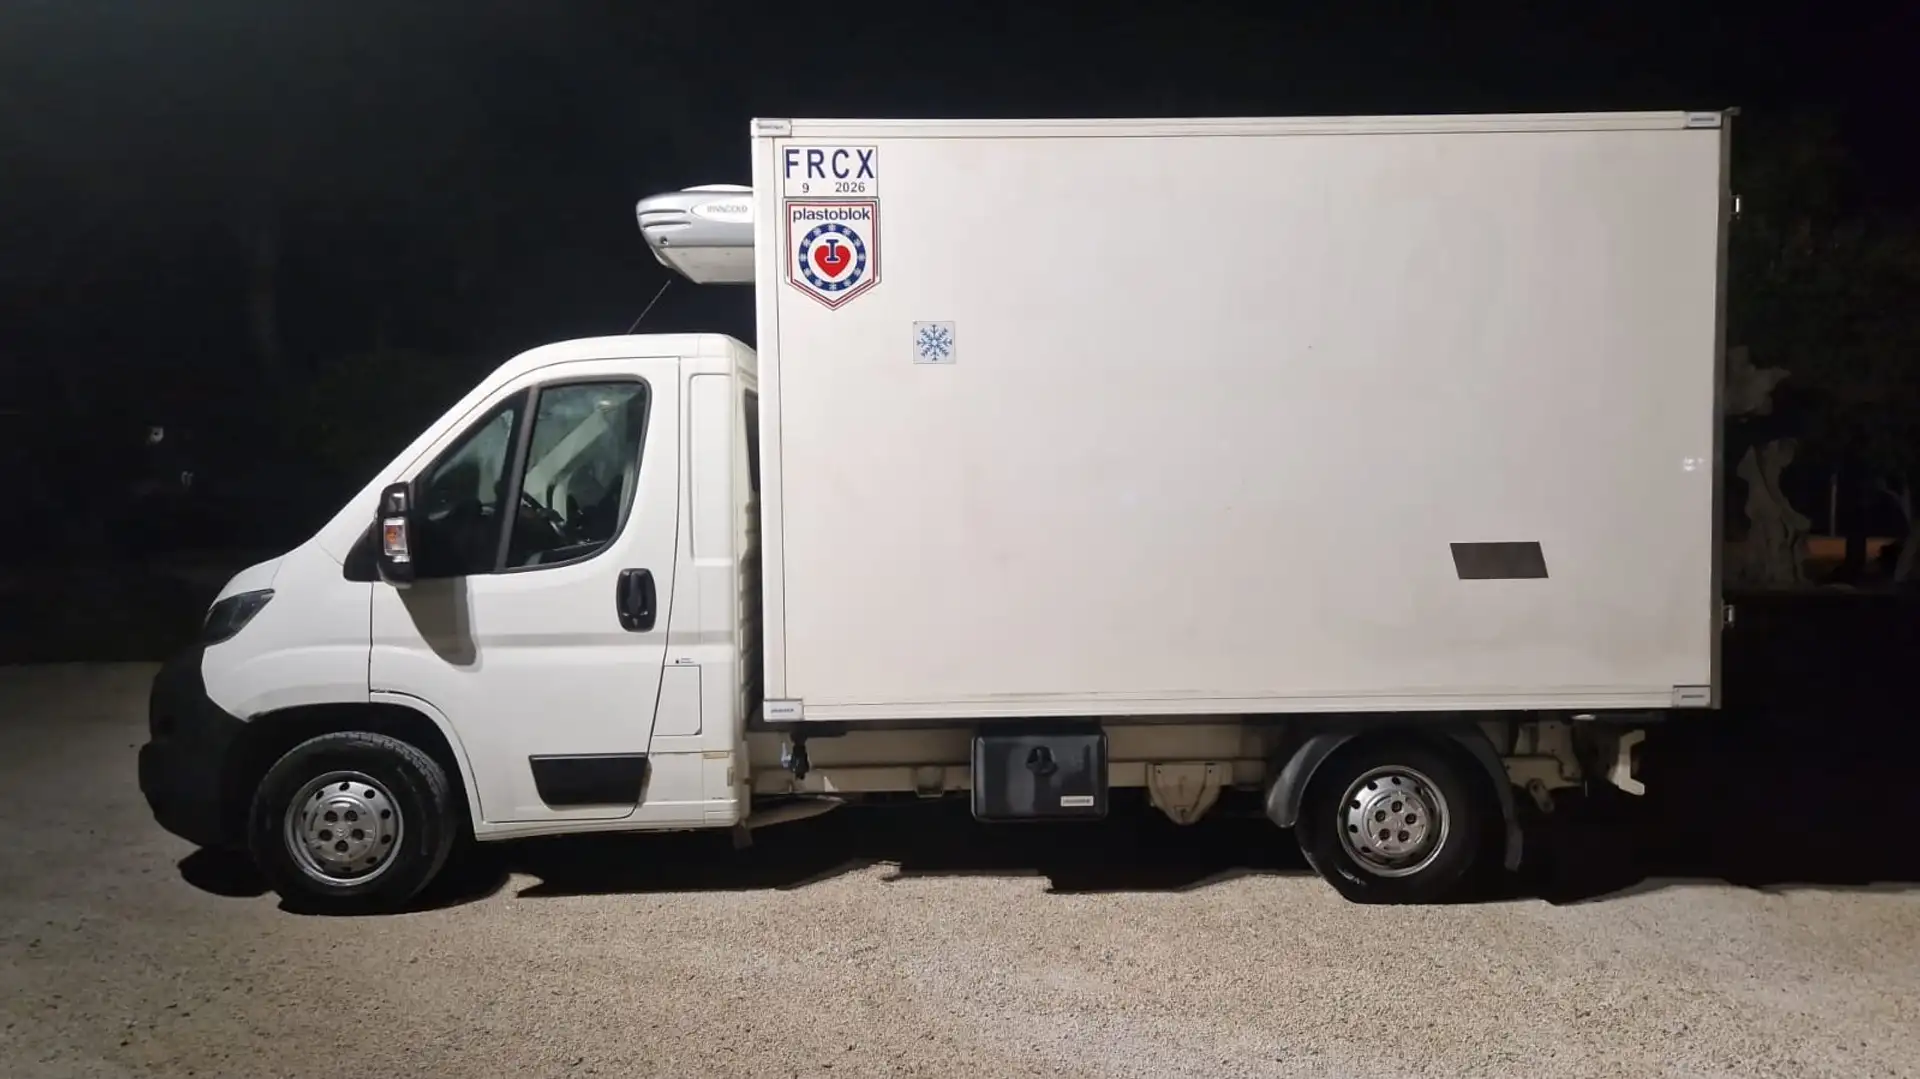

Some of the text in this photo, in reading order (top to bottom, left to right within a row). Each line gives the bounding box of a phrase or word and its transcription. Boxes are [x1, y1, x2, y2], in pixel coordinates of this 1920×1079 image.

[785, 149, 875, 179] FRCX
[802, 182, 865, 194] 9 2026
[793, 208, 871, 222] plastoblok
